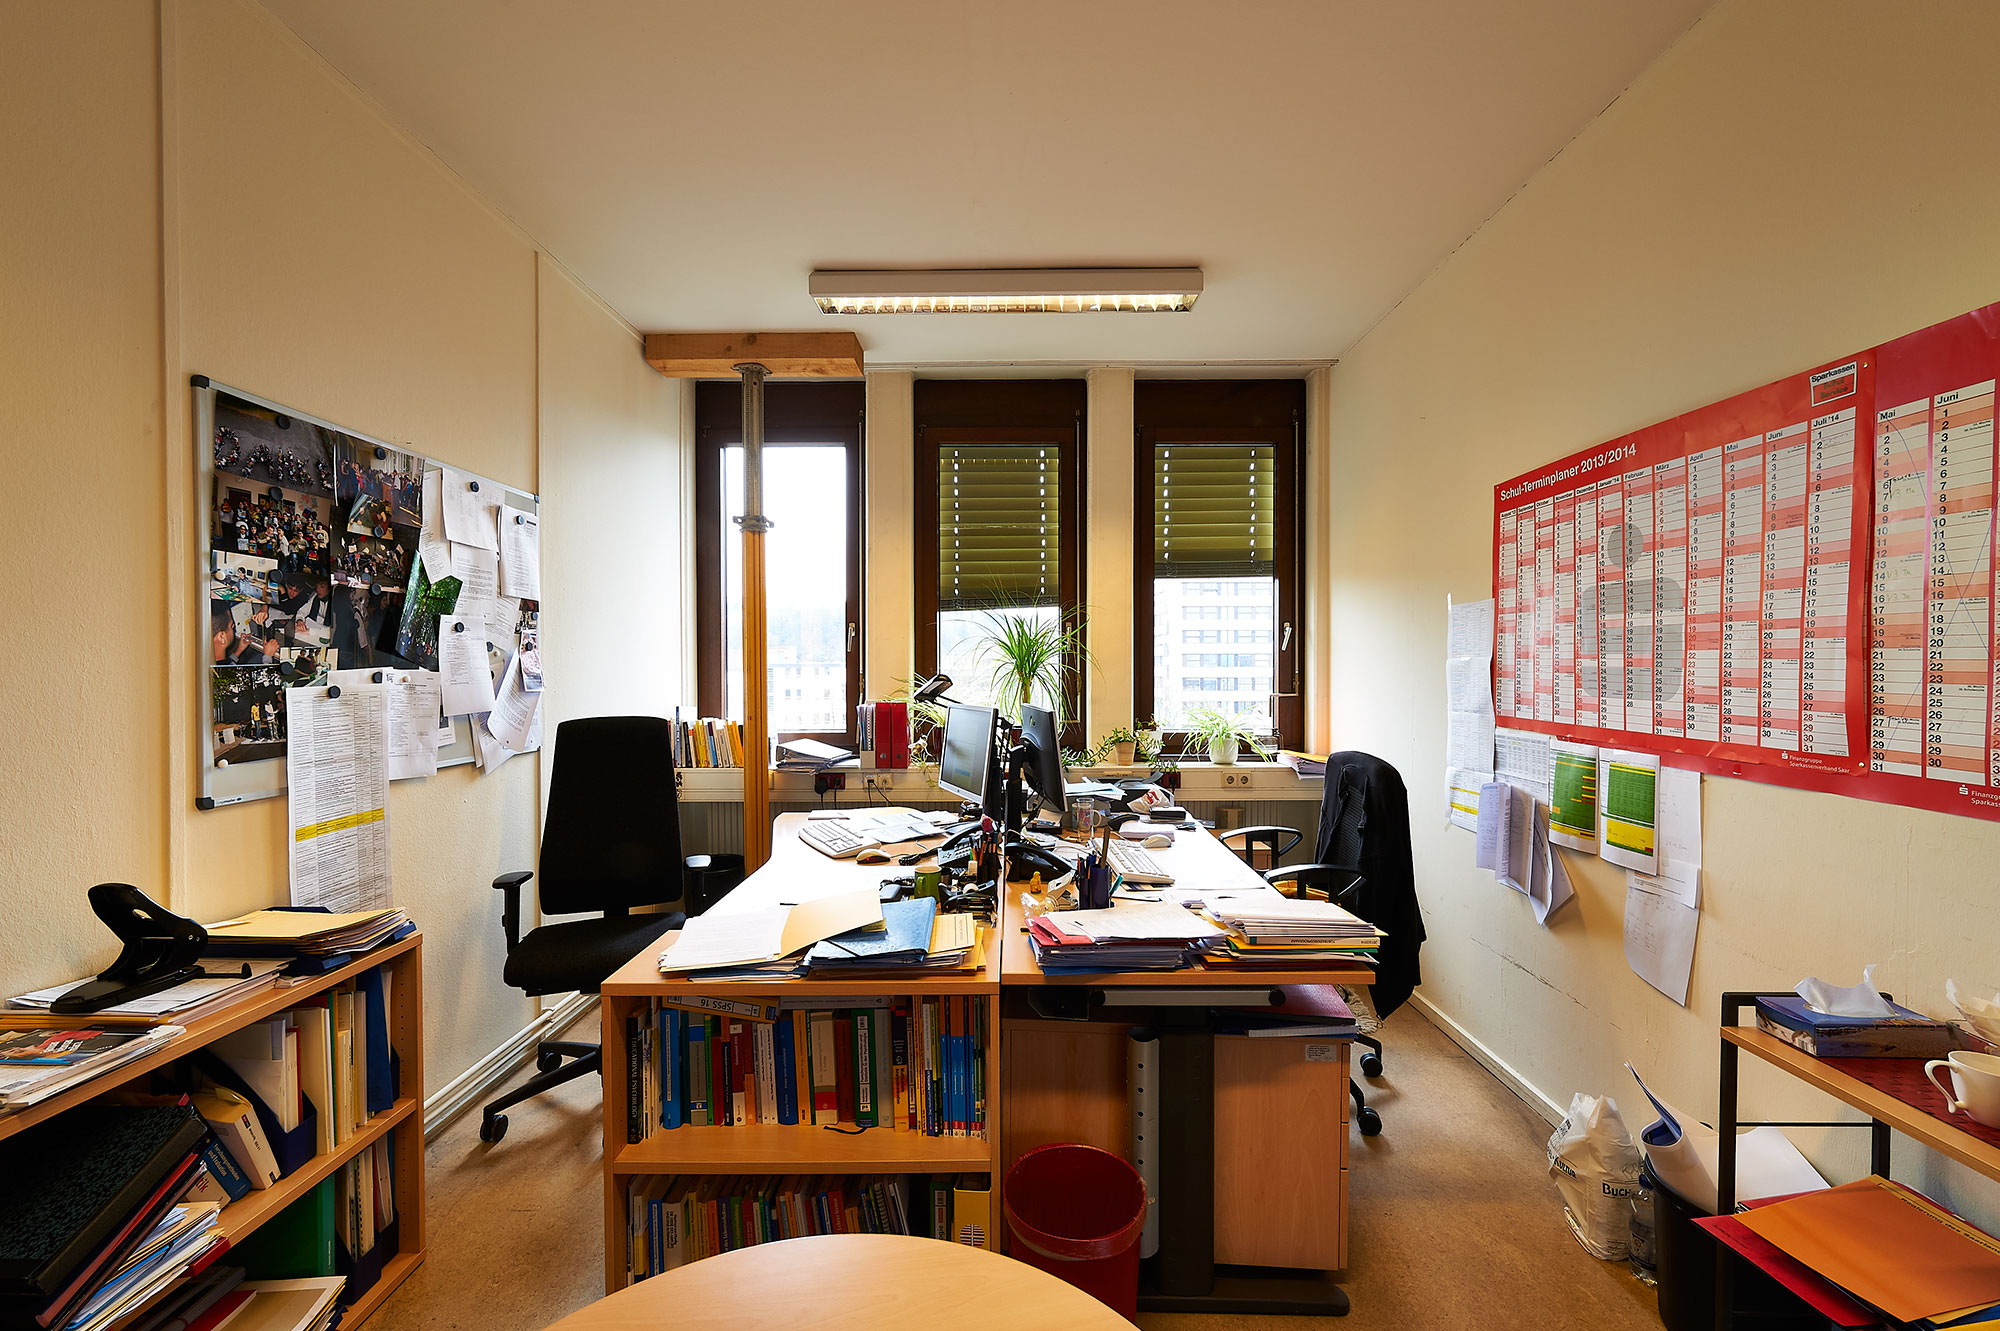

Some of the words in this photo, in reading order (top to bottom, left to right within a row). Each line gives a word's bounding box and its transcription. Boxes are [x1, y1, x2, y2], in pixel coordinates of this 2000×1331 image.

[1811, 363, 1855, 383] Sparkassen
[1937, 392, 1959, 404] Juni
[1880, 410, 1896, 420] Mai
[1943, 409, 1948, 417] 1
[1813, 417, 1827, 427] Juli
[1828, 414, 1839, 422] '14
[1941, 420, 1949, 430] 2
[1768, 430, 1783, 440] Juni
[1941, 433, 1949, 442] 3
[1884, 436, 1890, 444] 2
[1726, 443, 1739, 452] Mai
[1883, 447, 1890, 455] 3
[1941, 445, 1948, 454] 4
[1689, 453, 1704, 462] April
[1816, 452, 1822, 460] 3
[1883, 459, 1890, 467] 4
[1940, 457, 1948, 466] 5
[1656, 463, 1670, 472] März
[1816, 462, 1822, 470] 4
[1500, 465, 1579, 501] Schul-Terminplaner
[1581, 443, 1637, 473] 2013/2014
[1624, 470, 1645, 480] Februar
[1883, 470, 1889, 478] 5
[1940, 469, 1947, 478] 6
[1815, 473, 1822, 481] 5
[1940, 481, 1947, 490] 7
[1882, 493, 1889, 501] 7
[1939, 494, 1947, 503] 8
[1939, 506, 1947, 515] 9
[1933, 518, 1946, 527] 10
[1877, 527, 1888, 535] 10
[1933, 530, 1944, 539] 11
[1809, 536, 1819, 544] 11
[1932, 542, 1945, 551] 12
[1809, 547, 1819, 555] 12
[1876, 550, 1887, 558] 12
[1809, 557, 1819, 565] 13
[1932, 554, 1945, 563] 13
[1875, 561, 1886, 569] 13
[1931, 566, 1944, 575] 14
[1807, 578, 1817, 586] 15
[1931, 579, 1944, 587] 15
[1874, 584, 1885, 592] 15
[1873, 595, 1885, 603] 16
[1931, 591, 1944, 599] 16
[1806, 599, 1816, 607] 17
[1931, 603, 1944, 611] 17
[1873, 606, 1885, 614] 17
[1930, 615, 1944, 623] 18
[1805, 620, 1816, 628] 19
[1873, 629, 1885, 637] 19
[1930, 626, 1944, 635] 19
[1872, 640, 1885, 648] 20
[1929, 638, 1943, 647] 20
[1804, 651, 1815, 659] 22
[1872, 651, 1884, 659] 21
[1929, 650, 1942, 659] 21
[1804, 661, 1815, 669] 23
[1872, 662, 1884, 671] 22
[1929, 663, 1943, 671] 22
[1803, 672, 1814, 680] 24
[1872, 673, 1884, 682] 23
[1929, 675, 1943, 683] 23
[1803, 682, 1814, 690] 25
[1872, 685, 1884, 693] 24
[1929, 687, 1943, 695] 24
[1803, 693, 1814, 701] 26
[1872, 696, 1884, 704] 25
[1928, 698, 1943, 707] 25
[1803, 703, 1814, 711] 27
[1872, 707, 1884, 715] 26
[1803, 713, 1814, 721] 28
[1928, 710, 1942, 719] 26
[1872, 718, 1884, 726] 27
[1803, 724, 1814, 732] 29
[1928, 722, 1942, 731] 27
[1872, 729, 1885, 738] 28
[1803, 734, 1814, 742] 30
[1928, 734, 1942, 743] 28
[1803, 744, 1813, 752] 31
[1872, 740, 1885, 749] 29
[1928, 746, 1942, 756] 29
[1872, 752, 1885, 760] 30
[1872, 763, 1883, 771] 31
[1928, 758, 1942, 768] 30
[713, 1001, 732, 1011] SPSS
